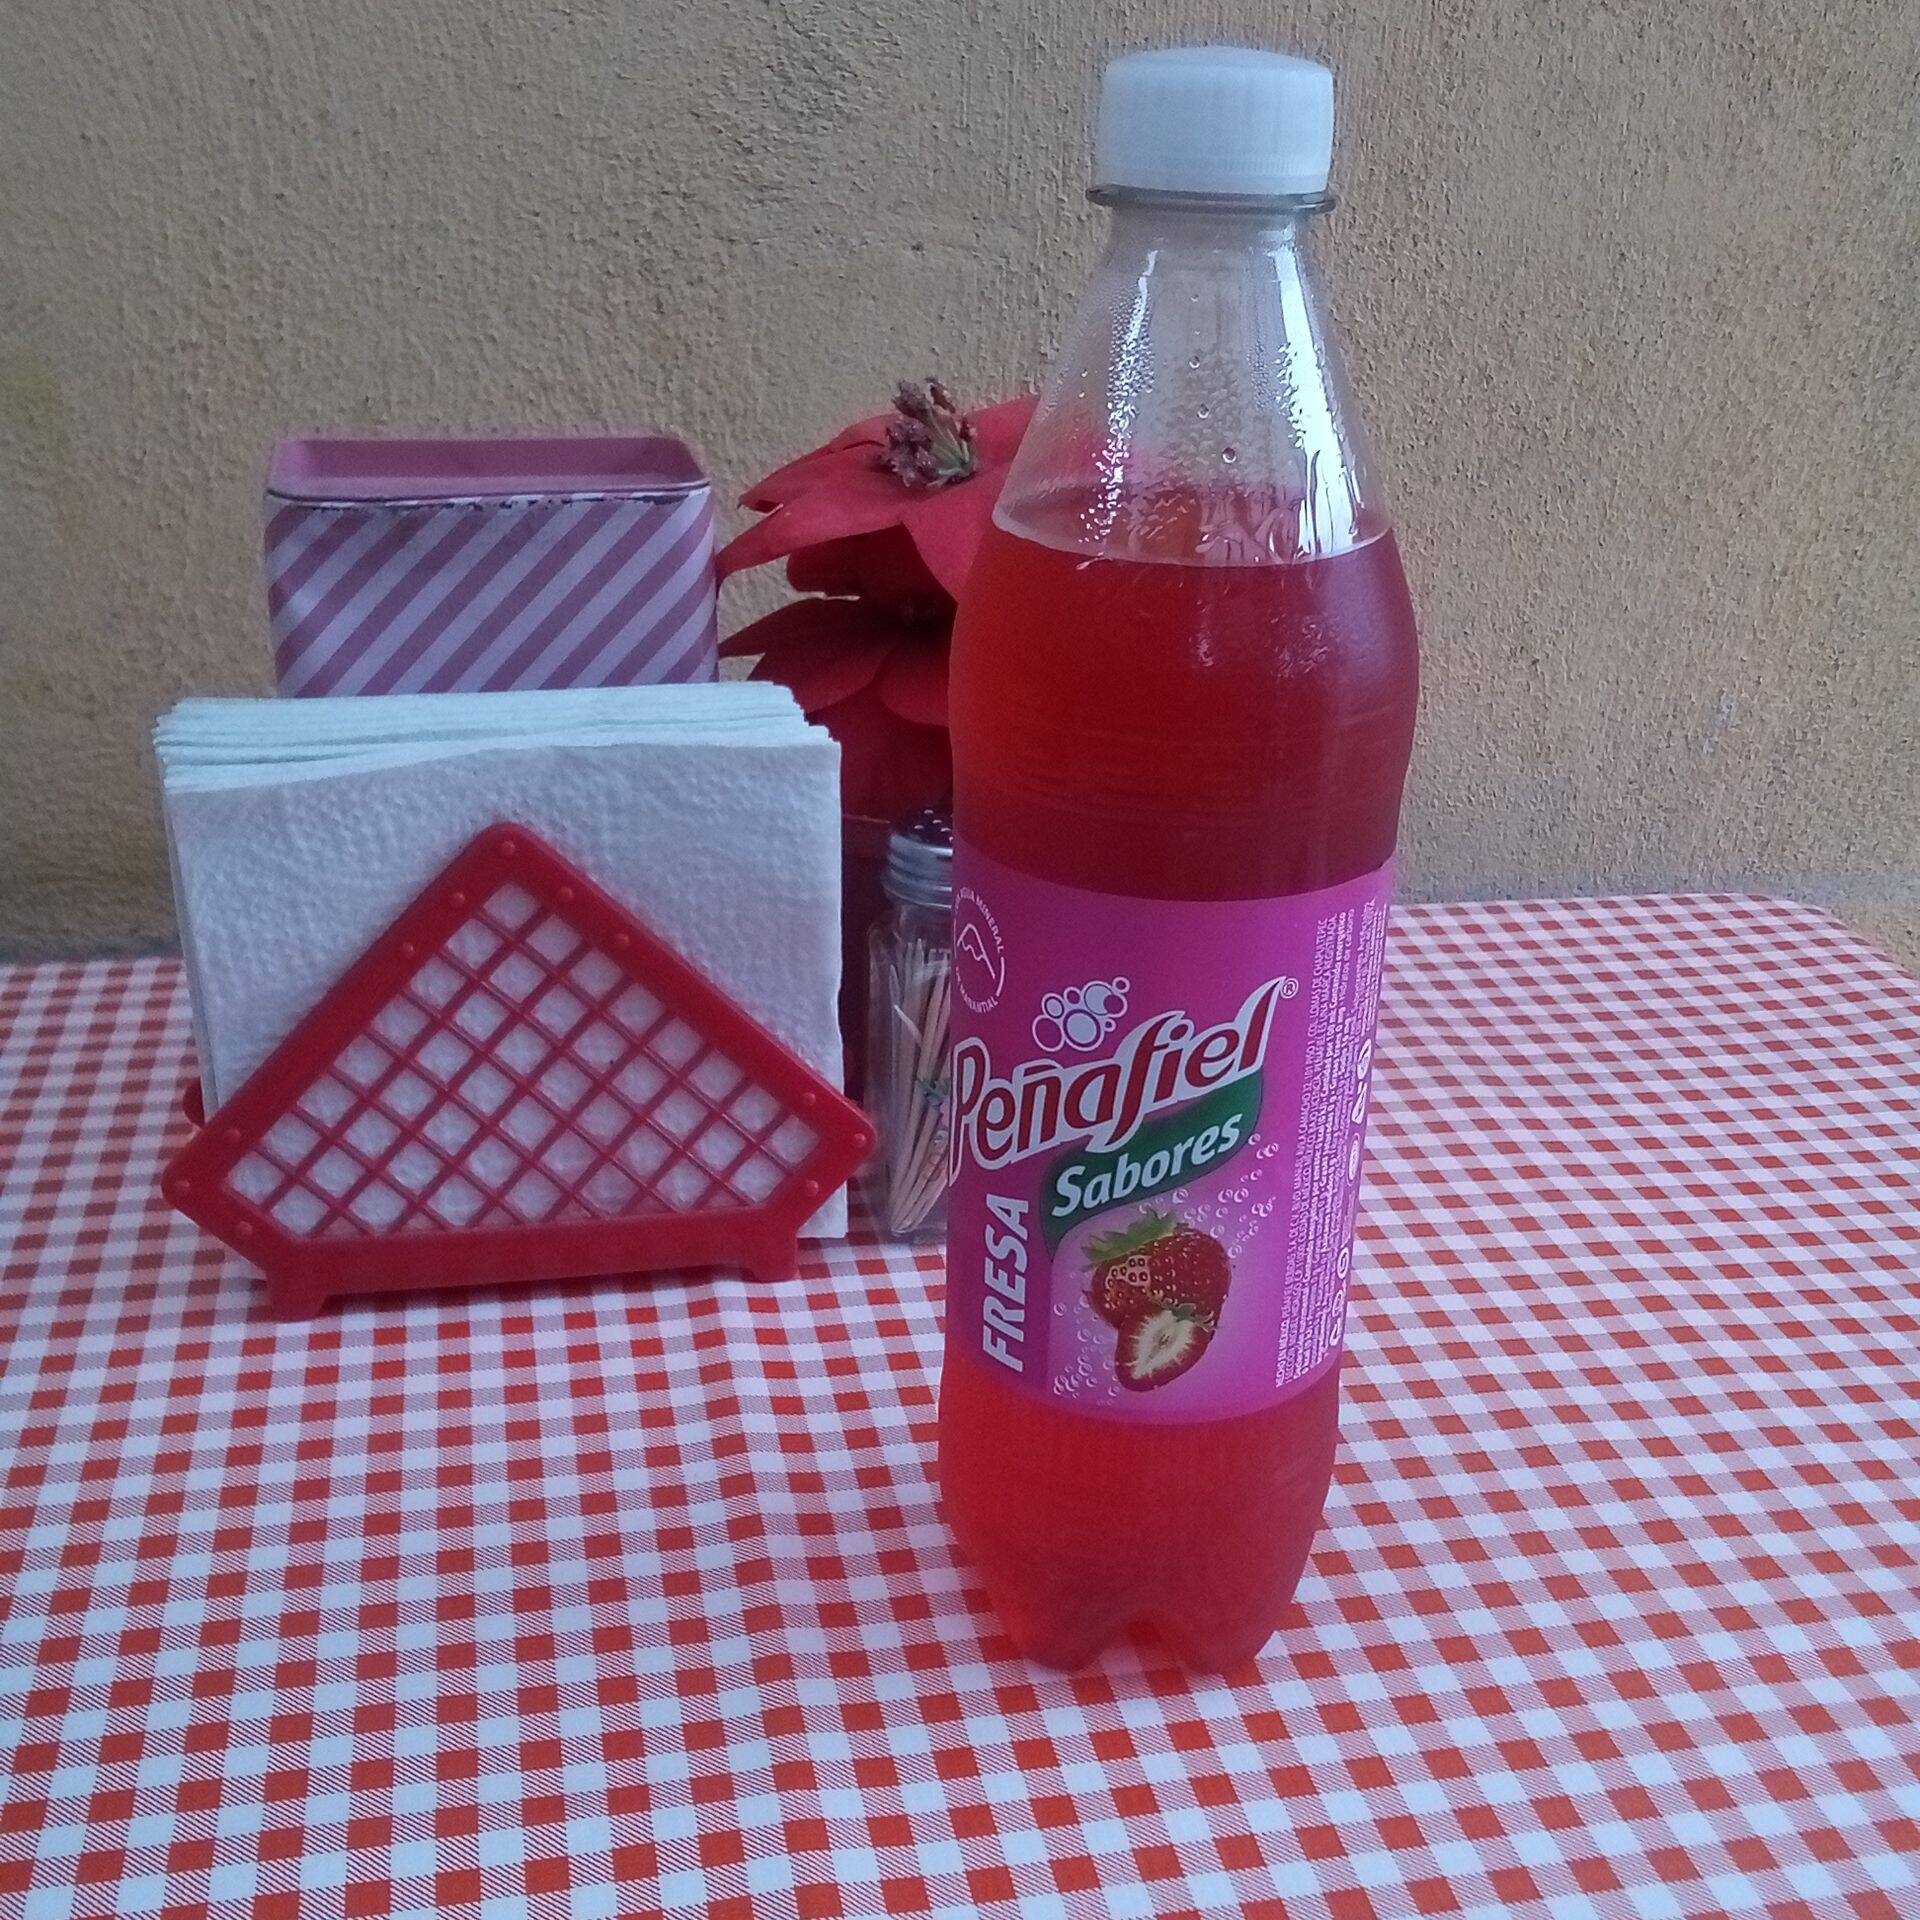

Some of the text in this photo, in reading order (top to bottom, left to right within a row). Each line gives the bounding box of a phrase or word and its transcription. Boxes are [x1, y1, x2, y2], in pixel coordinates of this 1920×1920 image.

[948, 976, 1286, 1187] Peñafiel
[1051, 1113, 1243, 1218] Sabores
[983, 1193, 1029, 1372] FRESA
